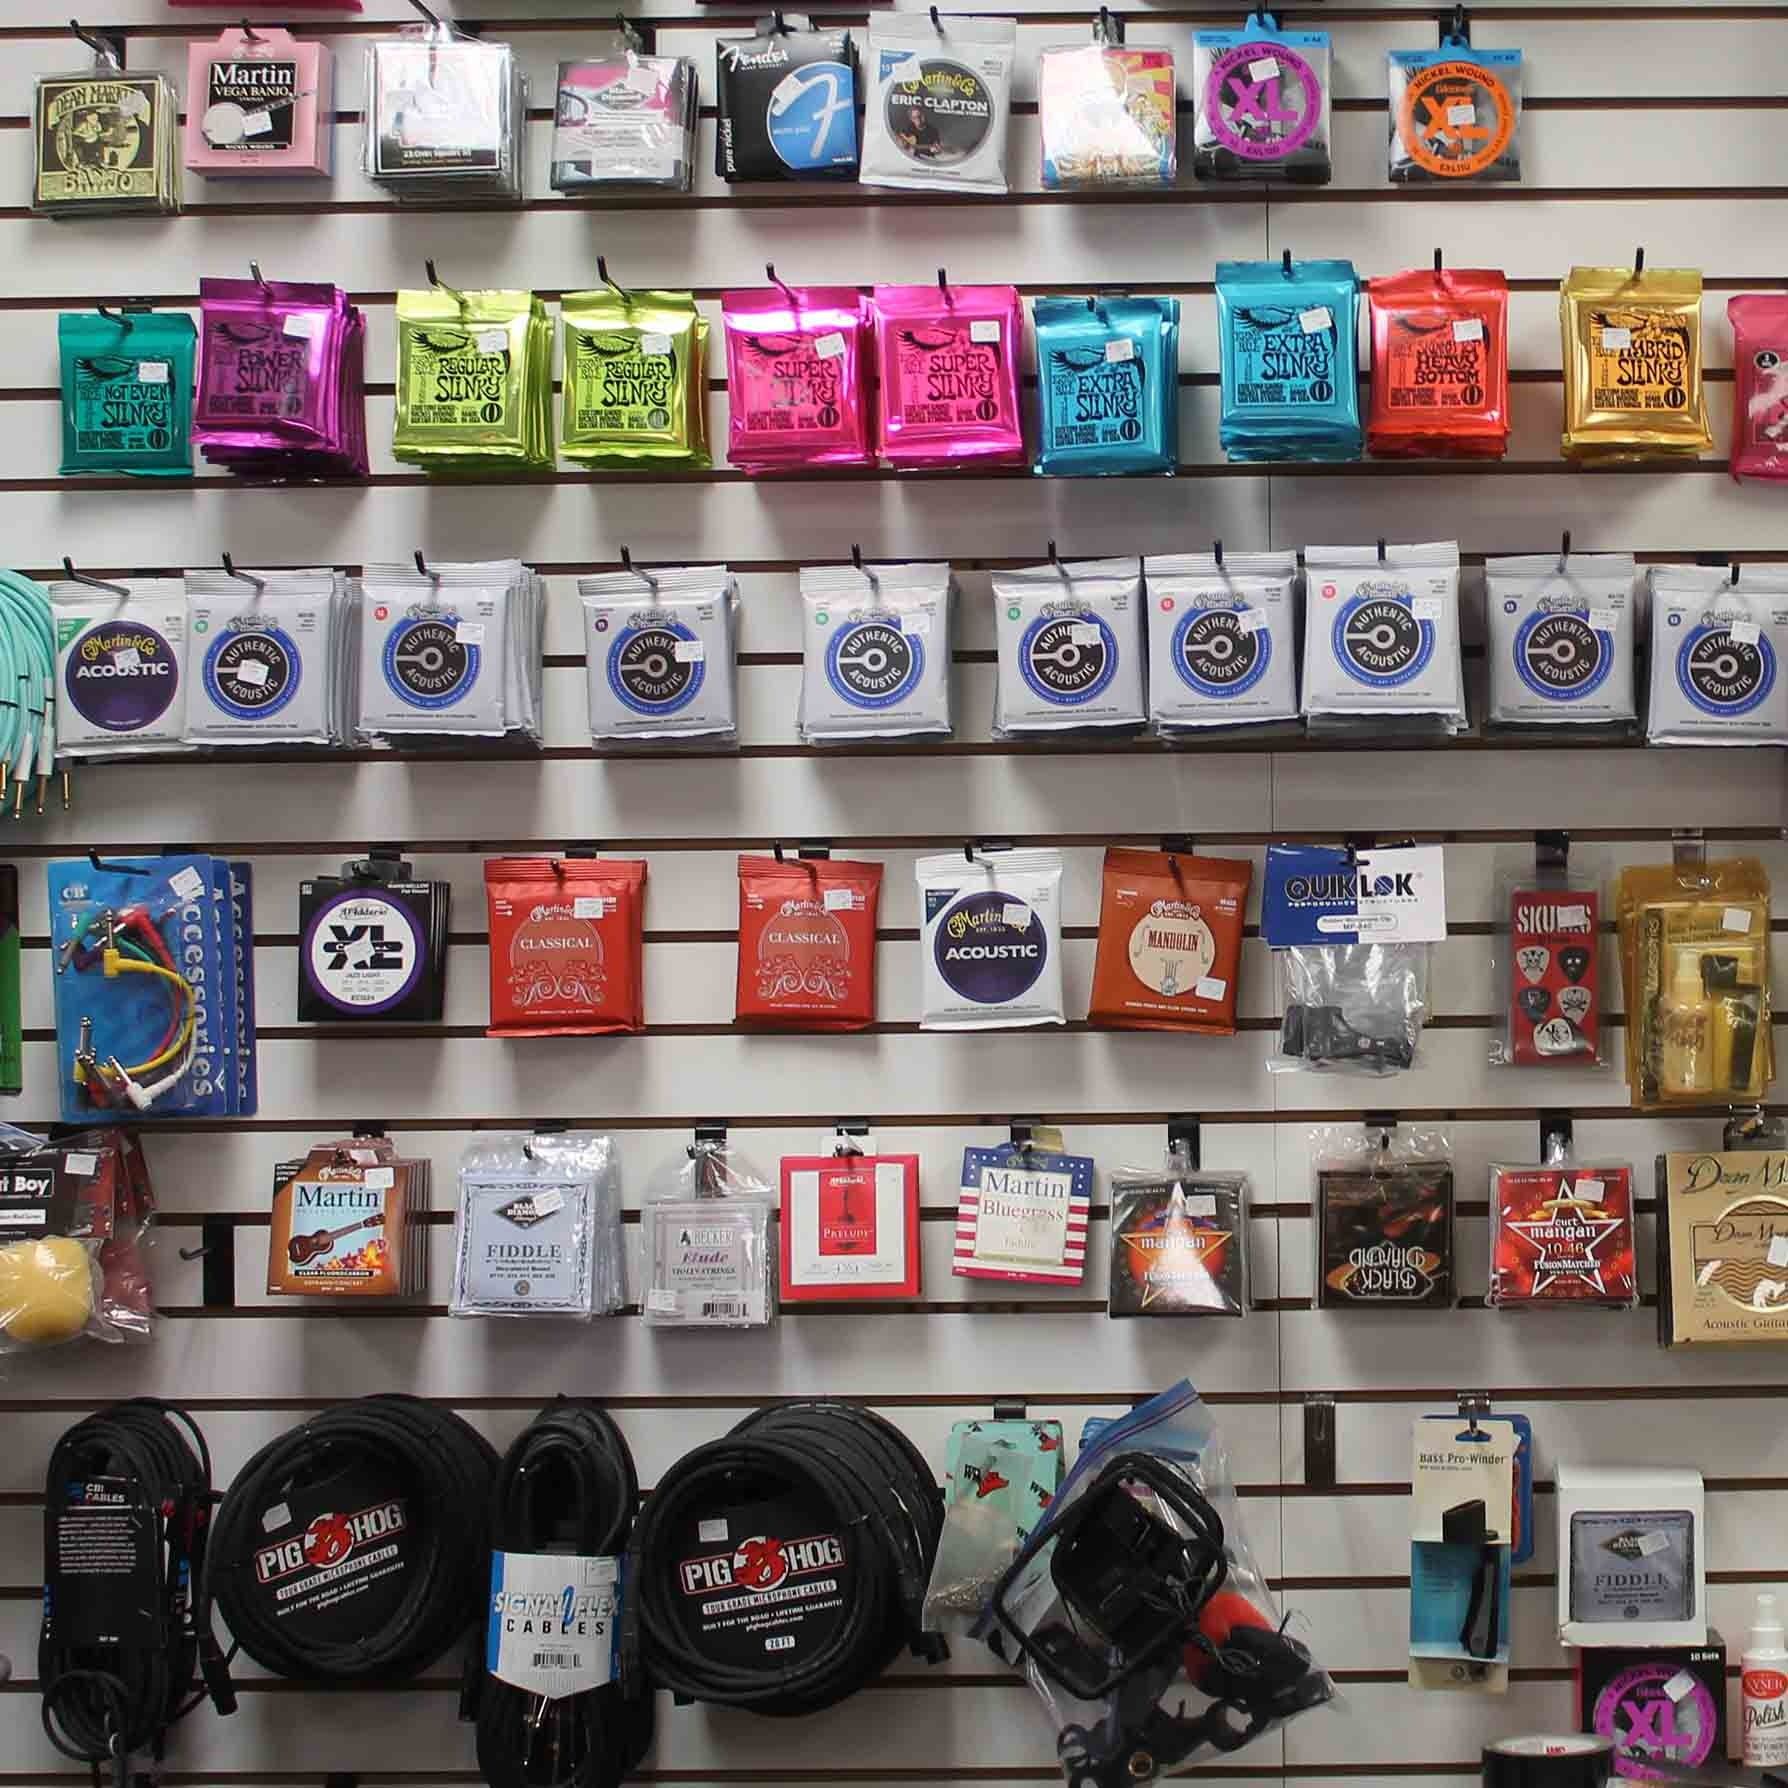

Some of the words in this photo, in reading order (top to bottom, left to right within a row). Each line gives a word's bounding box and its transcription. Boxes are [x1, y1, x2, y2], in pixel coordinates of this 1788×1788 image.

[719, 40, 789, 72] Fender
[212, 63, 292, 86] Martin
[1413, 66, 1450, 89] NICKEL
[1454, 64, 1496, 88] WOUND
[214, 86, 248, 97] VEGA
[251, 86, 289, 98] BANJO
[891, 94, 921, 105] ERIC
[924, 97, 988, 112] CLAPTON
[1226, 78, 1298, 121] XL
[726, 147, 737, 173] pure
[64, 166, 133, 193] BANJO
[1263, 332, 1329, 354] EXTRA
[1617, 338, 1684, 361] HYBRID
[239, 348, 302, 368] POWER
[438, 356, 505, 375] REGULAR
[774, 360, 837, 379] SUPER
[929, 352, 995, 372] SUPER
[1260, 350, 1329, 380] SLINKY
[1416, 348, 1480, 370] HEAVY
[604, 360, 671, 380] REGULAR
[1077, 370, 1137, 393] EXTRA
[1414, 368, 1481, 385] BOTTOM
[1616, 358, 1684, 387] SLINKY
[104, 384, 128, 400] NOT
[130, 383, 168, 400] EVEN
[434, 374, 502, 402] SLINKY
[600, 379, 668, 407] SLINKY
[926, 372, 994, 401] SLINKY
[101, 400, 168, 428] SLINKY
[1074, 390, 1139, 422] SLINKY
[1354, 605, 1412, 631] AUTHENTIC
[405, 627, 460, 652] AUTHENTIC
[847, 630, 903, 655] AUTHENTIC
[1535, 620, 1592, 646] AUTHENTIC
[225, 640, 281, 664] AUTHENTIC
[628, 636, 677, 662] AUTHENT
[1356, 644, 1410, 667] ACOUSTIC
[1699, 635, 1754, 662] AUTHENTIC
[76, 662, 169, 679] ACOUSTIC
[406, 666, 457, 689] ACOUSTIC
[848, 666, 902, 689] ACOUSTIC
[1043, 662, 1096, 685] ACOUSTIC
[1195, 655, 1248, 678] ACOUSTIC
[1538, 658, 1590, 681] ACOUSTIC
[226, 679, 279, 700] ACOUSTIC
[631, 671, 682, 696] ACOUSTIC
[1701, 675, 1753, 697] ACOUSTIC
[1517, 905, 1591, 934] SKUS
[324, 925, 403, 970] XL
[520, 937, 593, 950] CLASSICAL
[768, 931, 841, 945] CLASSICAL
[1148, 930, 1200, 951] MANDOLIN
[945, 944, 1038, 961] ACOUSTIC
[14, 1176, 50, 1196] Boy
[984, 1170, 1065, 1199] Martin
[1681, 1155, 1751, 1194] Dean
[298, 1185, 379, 1208] Martin
[983, 1200, 1063, 1222] Bluegrass
[1554, 1218, 1578, 1227] curt
[1530, 1226, 1597, 1242] mangan
[487, 1244, 562, 1258] FIDDLE
[1361, 1267, 1417, 1289] BLACK
[1703, 1316, 1748, 1329] Acoustic
[1419, 1453, 1445, 1464] Bass
[85, 1492, 126, 1503] CABLES
[258, 1541, 305, 1580] PIG
[352, 1503, 403, 1543] HOG
[684, 1559, 733, 1591] PIG
[786, 1538, 843, 1572] HOG
[506, 1617, 605, 1635] CABLES
[1621, 1699, 1693, 1747] XL
[1744, 1700, 1786, 1734] Polish
